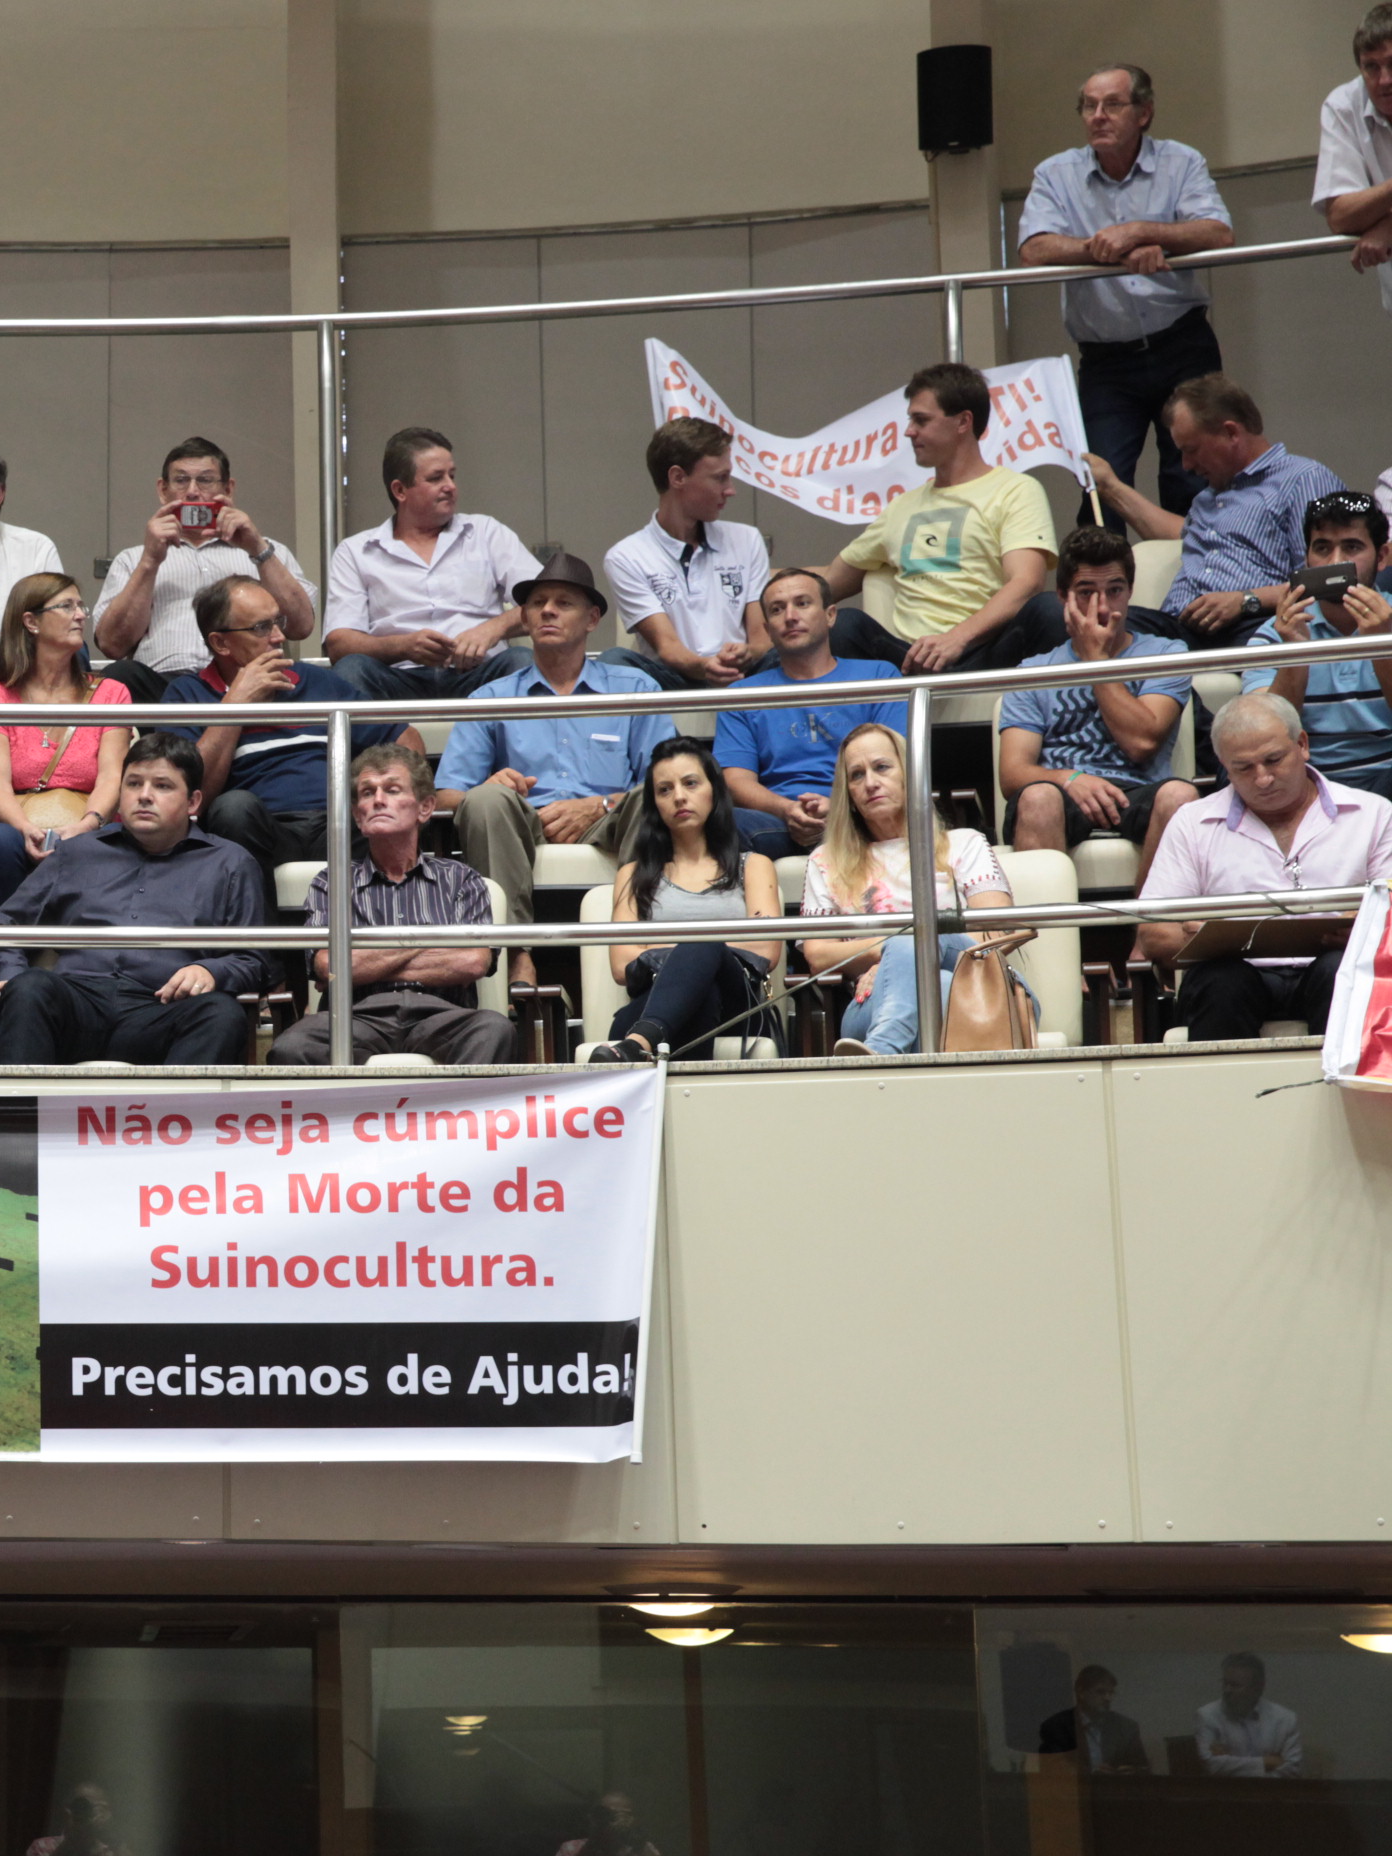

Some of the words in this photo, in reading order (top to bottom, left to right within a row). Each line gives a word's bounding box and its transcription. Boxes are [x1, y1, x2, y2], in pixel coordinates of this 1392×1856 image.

[663, 360, 898, 478] Suinocultura
[978, 377, 1043, 441] TI!
[77, 1103, 193, 1147] Não
[215, 1100, 331, 1155] seja
[353, 1096, 626, 1151] cúmplice
[139, 1171, 265, 1228] pela
[288, 1170, 472, 1214] Morte
[492, 1166, 566, 1213] da
[150, 1241, 556, 1289] Suinocultura.
[71, 1354, 369, 1396] Precisamos
[386, 1353, 452, 1395] de
[468, 1352, 631, 1406] Ajuda!
